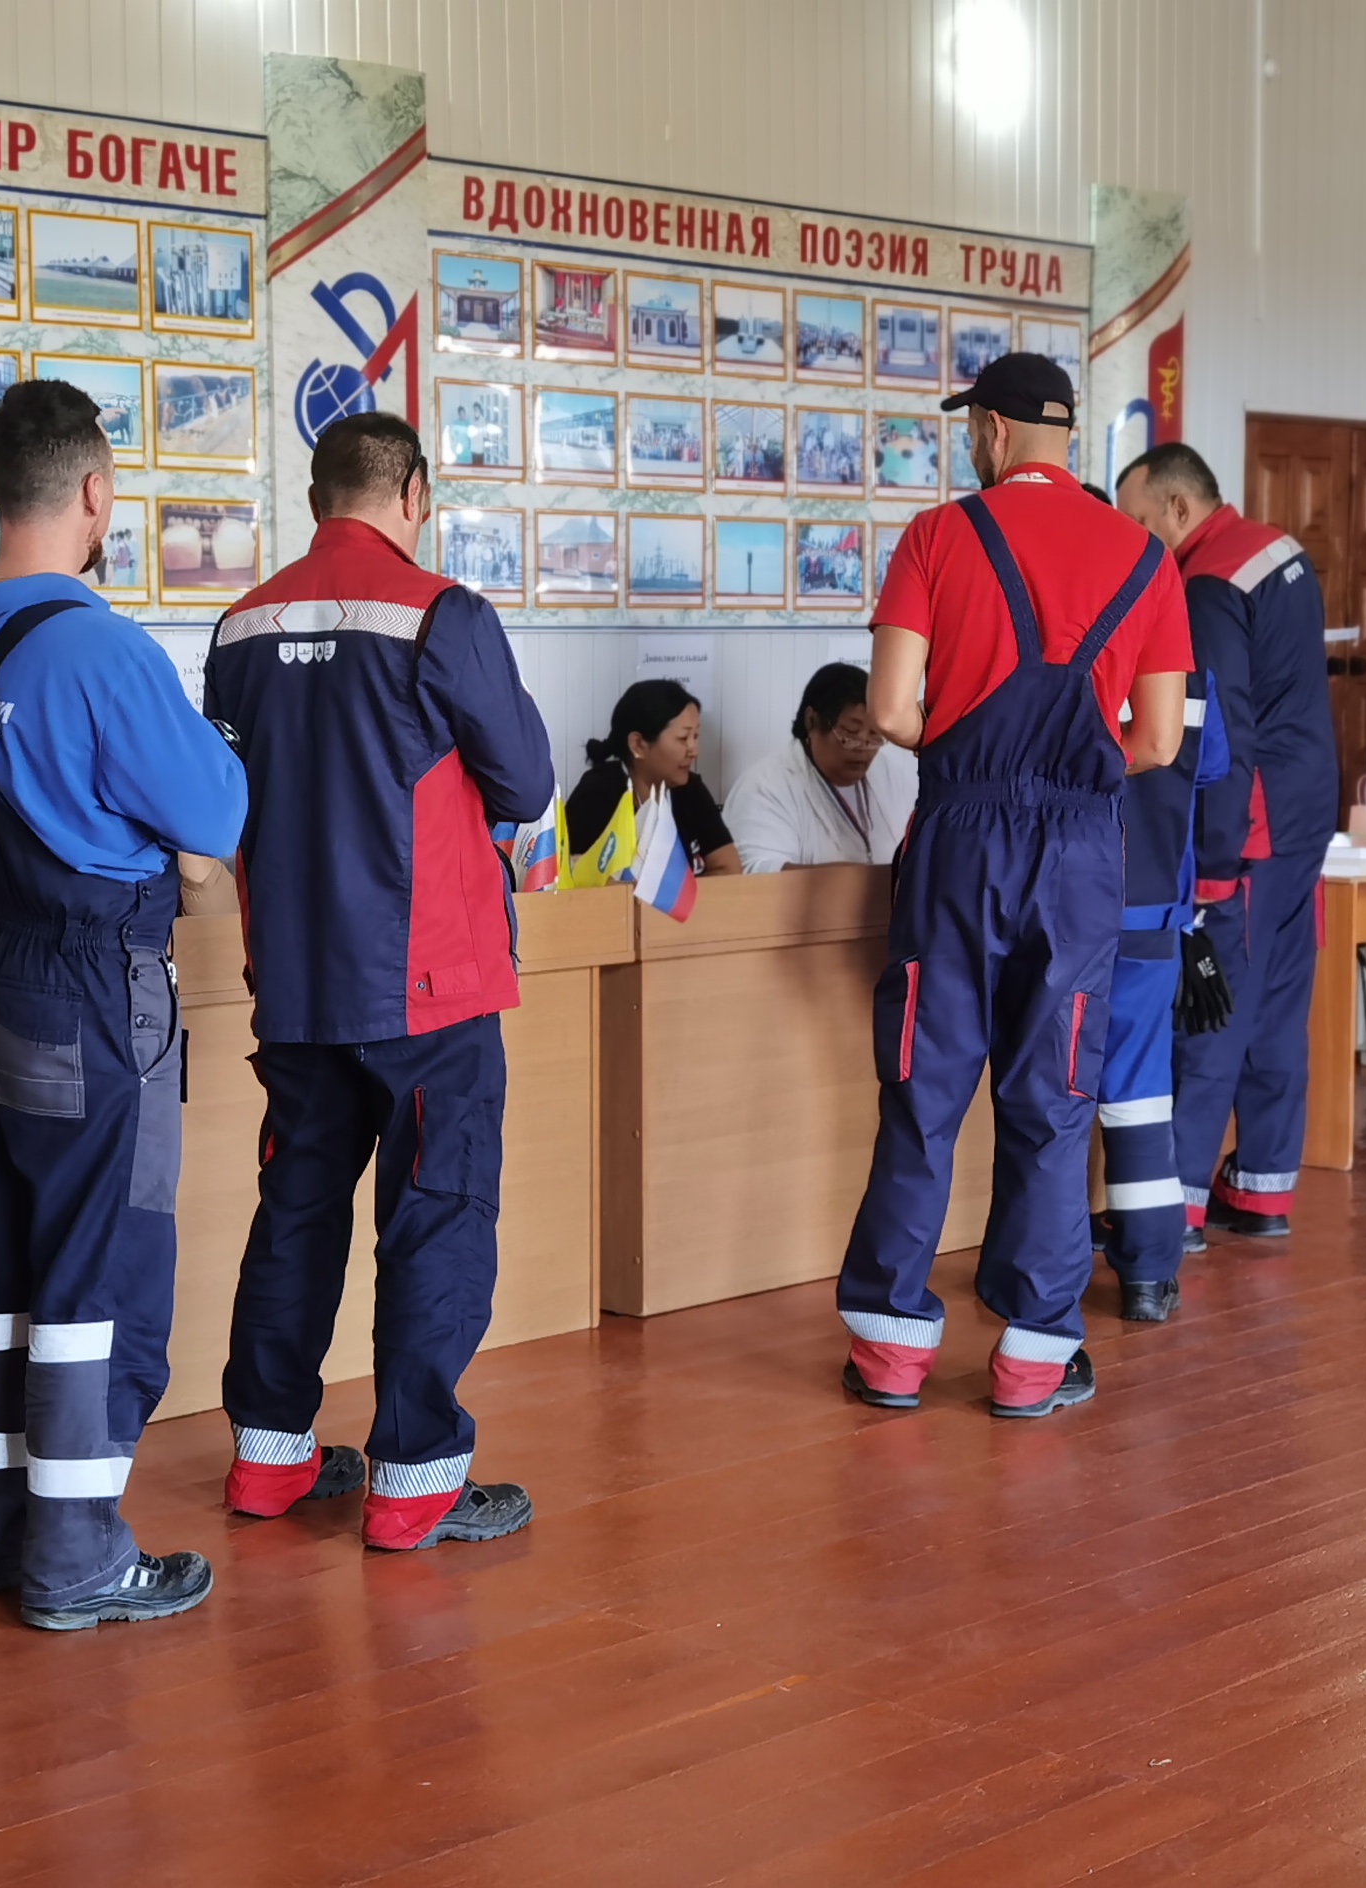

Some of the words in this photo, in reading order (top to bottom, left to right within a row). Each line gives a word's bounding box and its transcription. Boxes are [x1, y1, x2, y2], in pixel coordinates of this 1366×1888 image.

[67, 129, 238, 197] БОГАЧЕ
[462, 175, 771, 258] ВДОХНОВЕННАЯ
[799, 222, 930, 278] ПОЭЗИЯ
[959, 244, 1063, 297] ТРУДА
